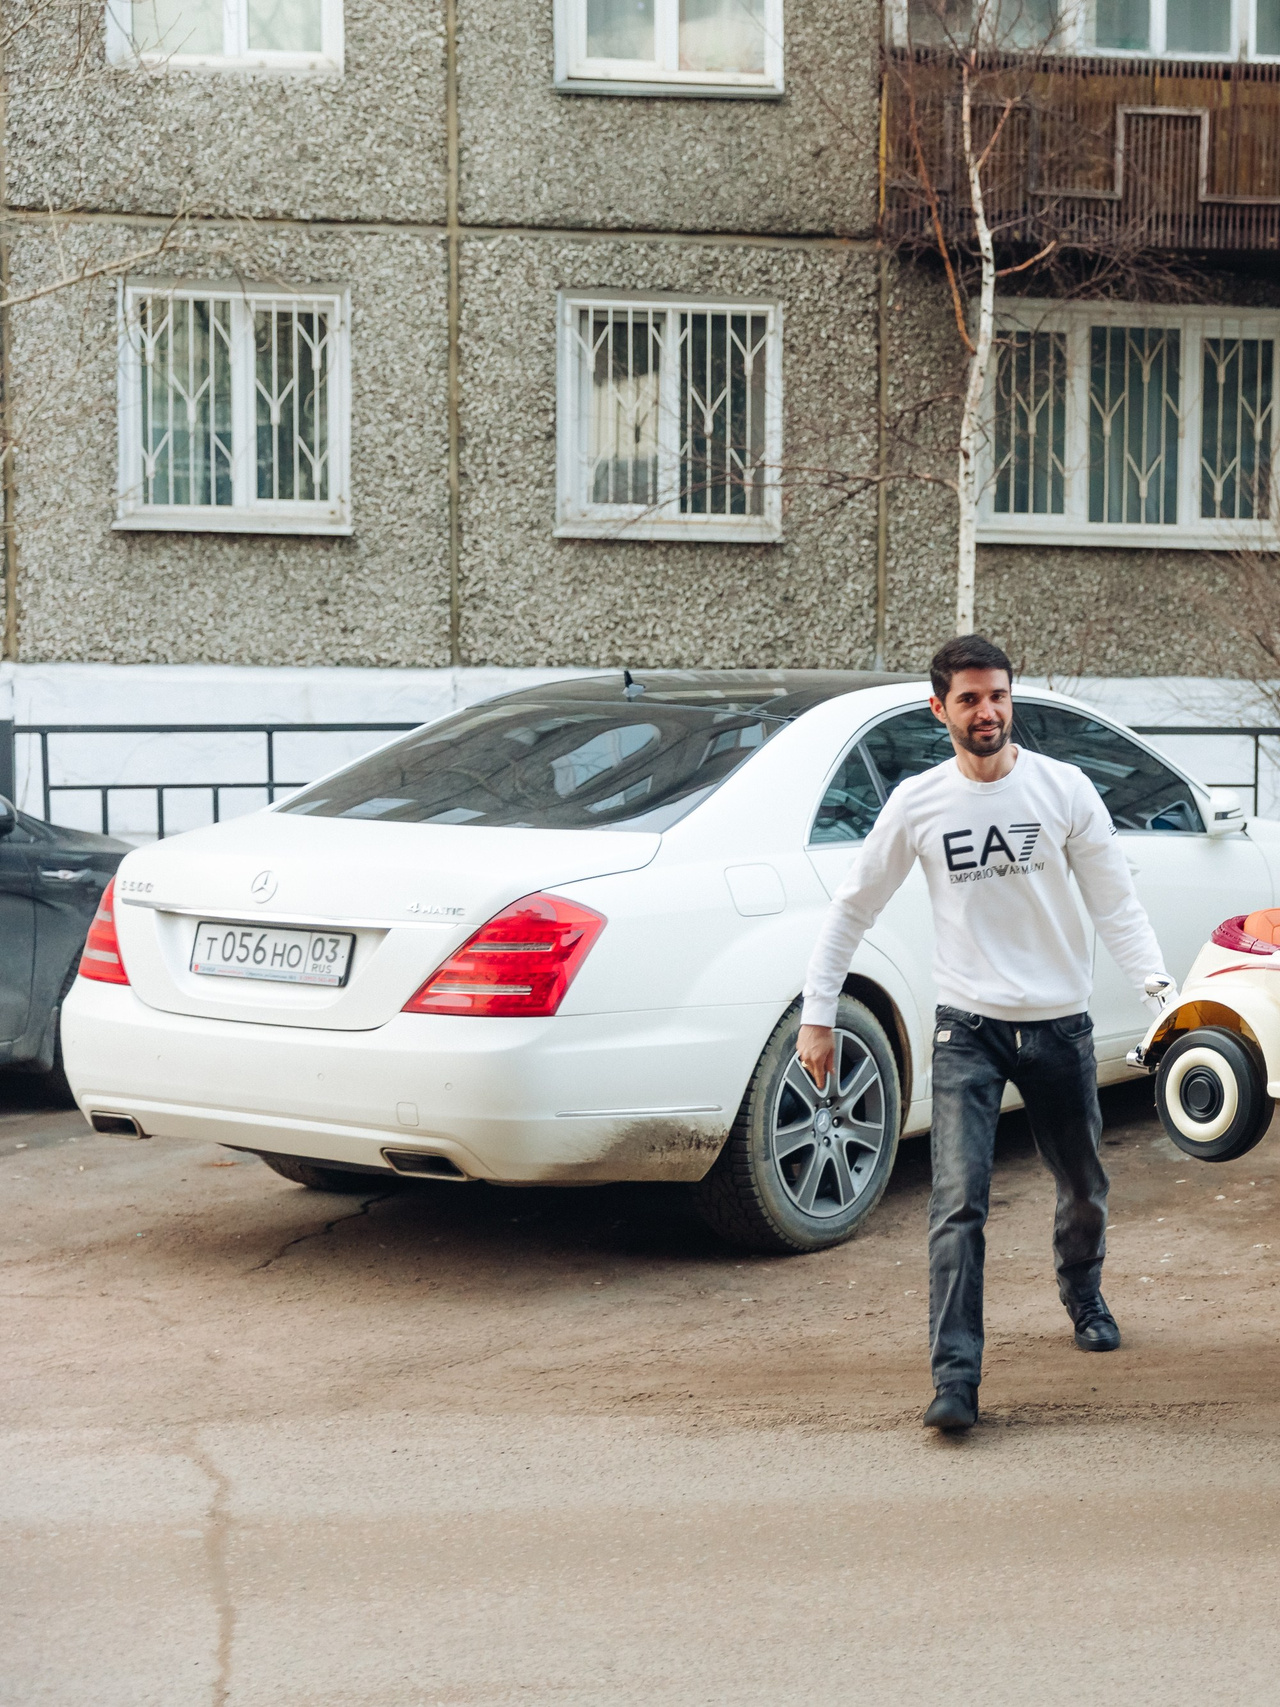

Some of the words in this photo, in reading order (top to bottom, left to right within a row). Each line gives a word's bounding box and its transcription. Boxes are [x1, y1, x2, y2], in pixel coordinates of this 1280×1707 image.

[942, 822, 1042, 872] EA7
[950, 868, 994, 884] EMPORIO
[1009, 862, 1046, 875] ARMANI
[311, 937, 341, 963] 03
[311, 963, 333, 974] RUS
